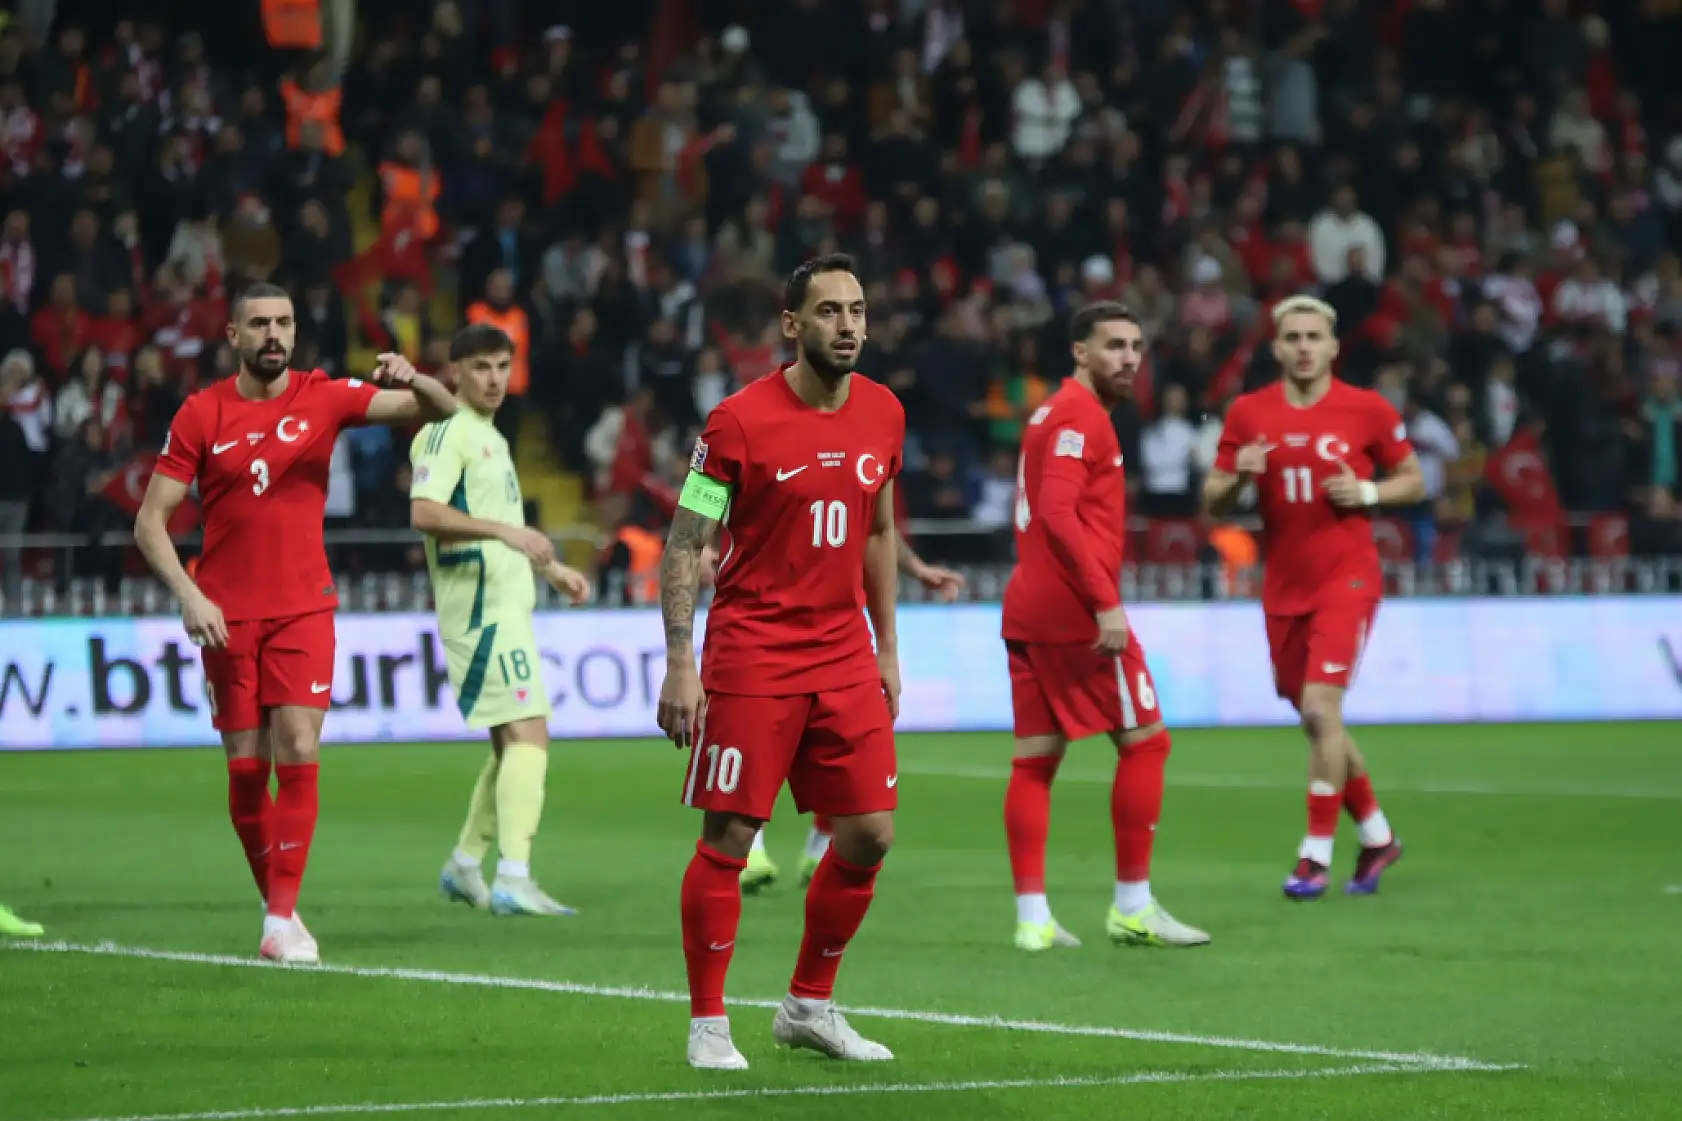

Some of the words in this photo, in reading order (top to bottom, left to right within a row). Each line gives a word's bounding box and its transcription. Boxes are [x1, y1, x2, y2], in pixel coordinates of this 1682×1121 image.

[251, 459, 270, 497] 3
[1282, 466, 1314, 504] 11
[810, 500, 848, 547] 10
[499, 649, 531, 685] 18
[1137, 672, 1155, 710] 6
[705, 744, 743, 793] 10
